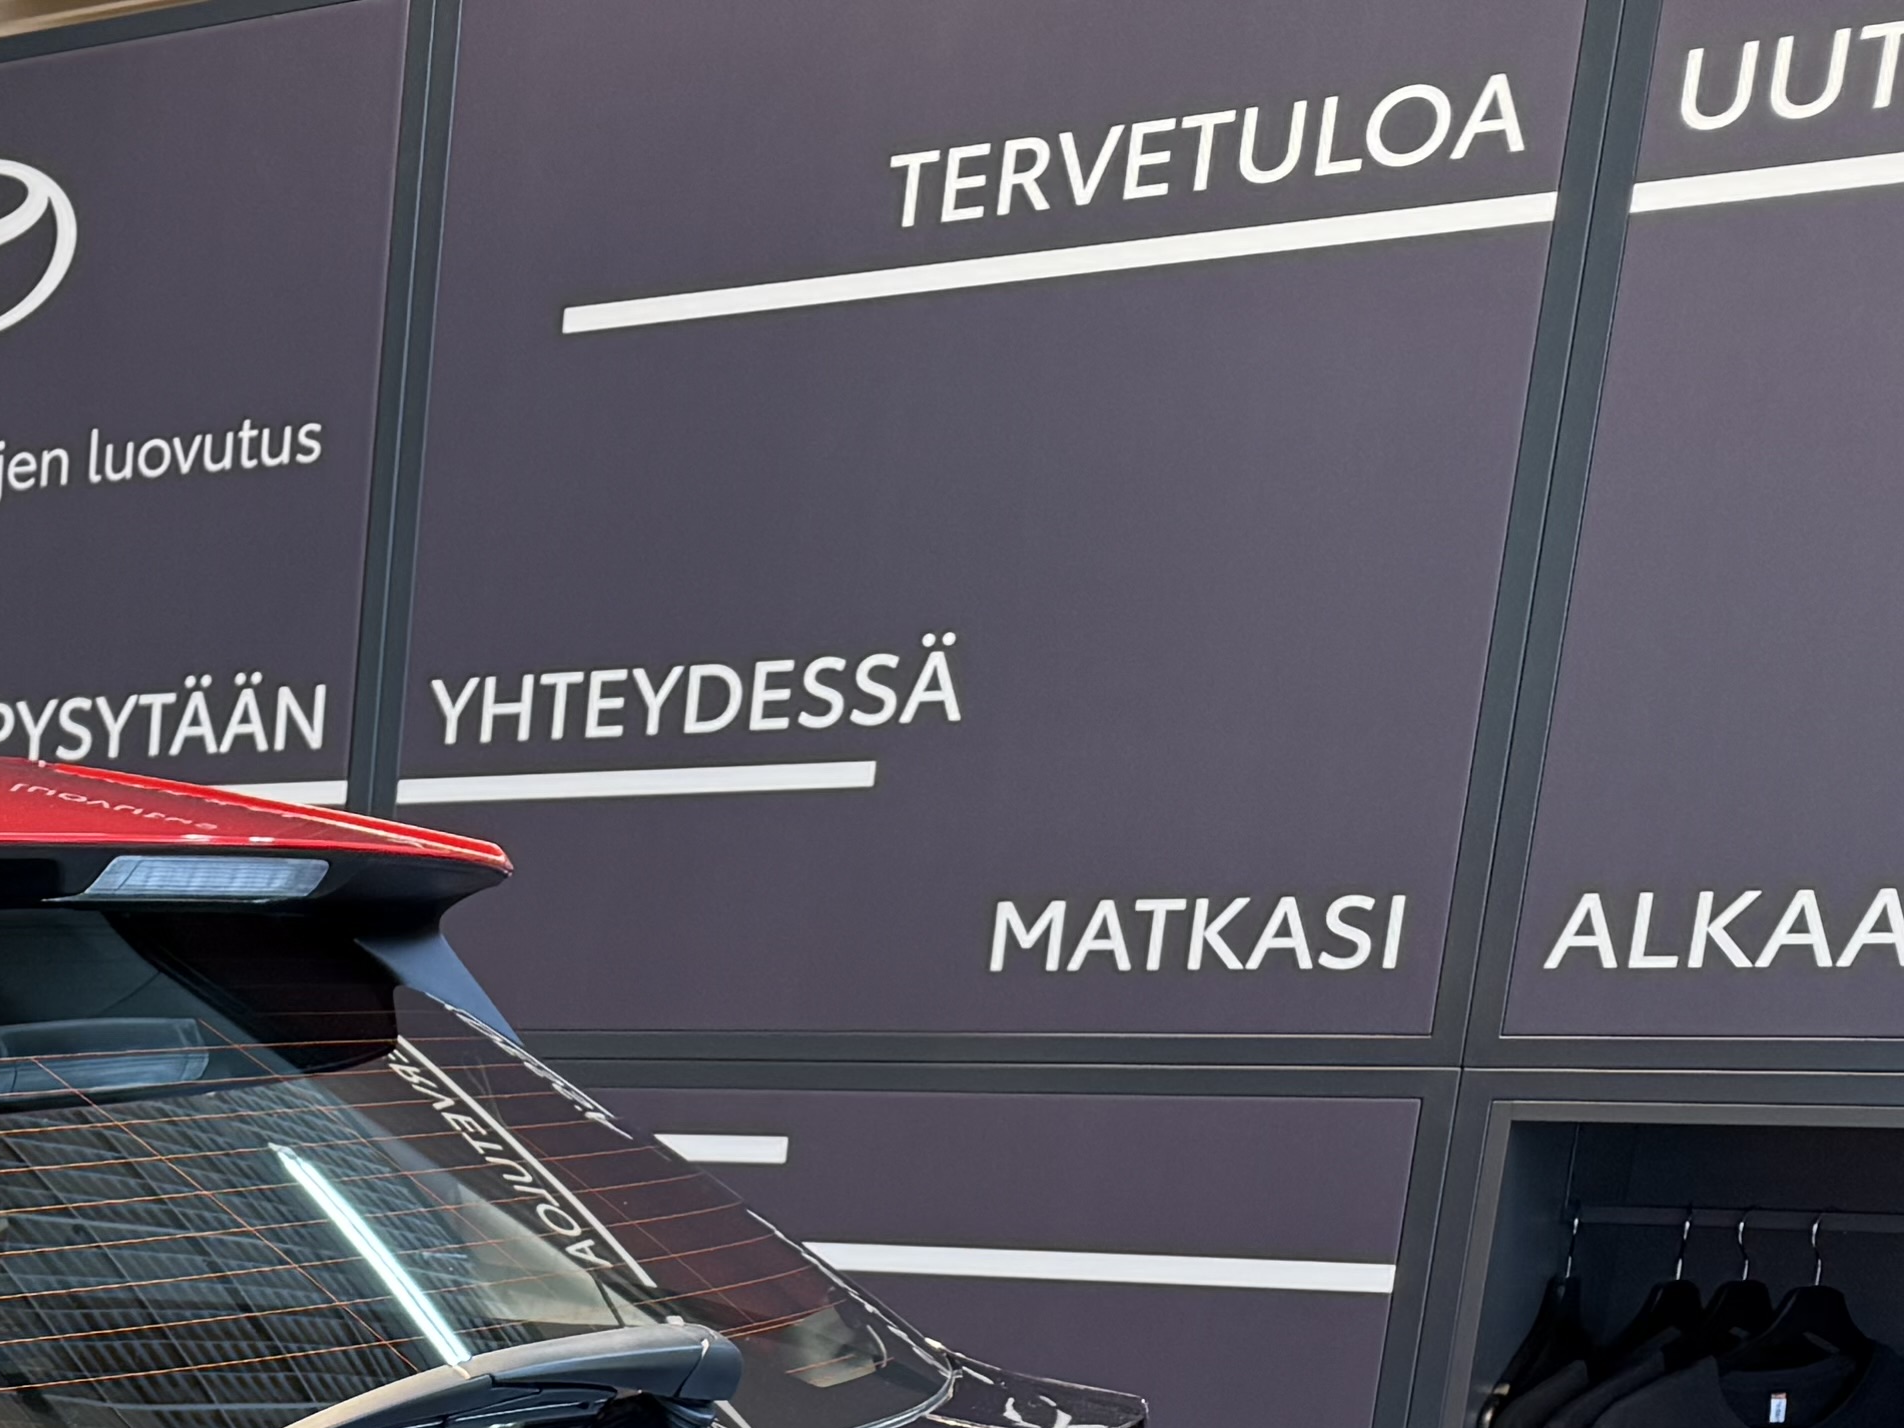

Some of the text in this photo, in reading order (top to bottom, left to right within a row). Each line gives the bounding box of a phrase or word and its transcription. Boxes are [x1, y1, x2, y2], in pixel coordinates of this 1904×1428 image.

[890, 20, 1904, 229] TERVETULOA UUT
[88, 418, 322, 484] luovutus
[432, 632, 961, 745] YHTEYDESSÄ
[989, 887, 1904, 972] MATKASI ALKAA
